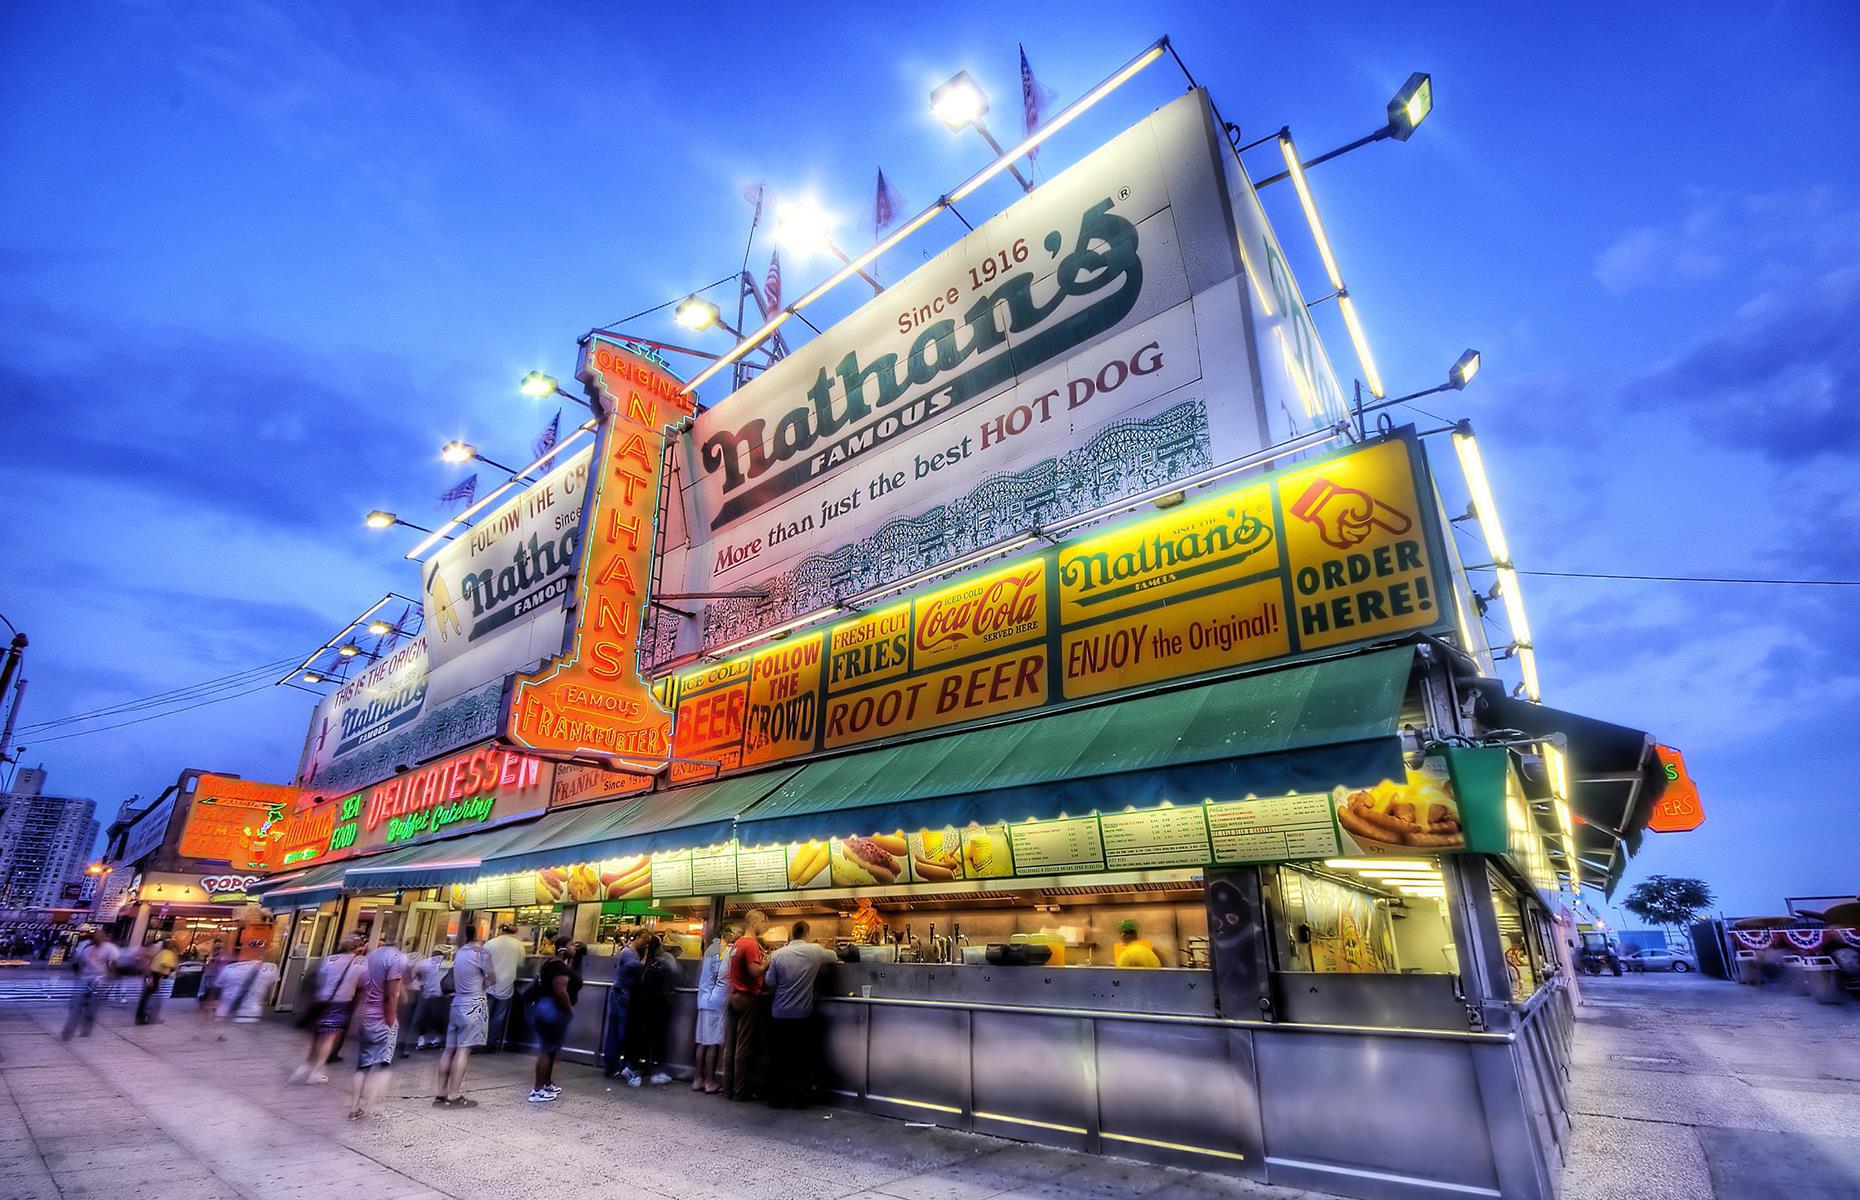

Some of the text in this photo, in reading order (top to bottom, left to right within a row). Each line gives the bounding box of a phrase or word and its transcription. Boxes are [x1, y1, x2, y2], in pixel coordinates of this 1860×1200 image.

[898, 237, 1030, 334] Since 1916
[808, 386, 954, 476] FAMOUS
[714, 341, 1164, 574] More than just the best HOT DOG
[554, 506, 581, 530] Since
[589, 389, 657, 682] NATHANS
[1060, 508, 1273, 592] Nathan's
[1296, 541, 1424, 595] ORDER
[916, 567, 1042, 651] Coca-Cola
[963, 587, 984, 599] COLD
[1303, 576, 1432, 636] HERE!
[833, 611, 909, 650] FRESH CUT
[983, 620, 1039, 643] SERVED HERE
[1068, 602, 1279, 679] ENJOY the Original!
[682, 660, 749, 692] ICE COLD
[753, 640, 820, 682] FOLLOW
[831, 633, 907, 684] FRIES
[335, 683, 355, 709] THIS
[367, 661, 388, 687] THE
[567, 687, 640, 716] FAMOUS
[769, 672, 799, 701] THE
[826, 655, 1044, 739] ROOT BEER
[522, 692, 672, 756] FRANKFURTERS
[675, 689, 744, 748] BEER
[746, 690, 815, 750] CROWD
[341, 794, 361, 821] SEA
[366, 748, 540, 832] DELICATESSEN
[604, 779, 626, 791] Since
[329, 822, 356, 850] FOOD
[386, 796, 496, 842] Buffet Catering
